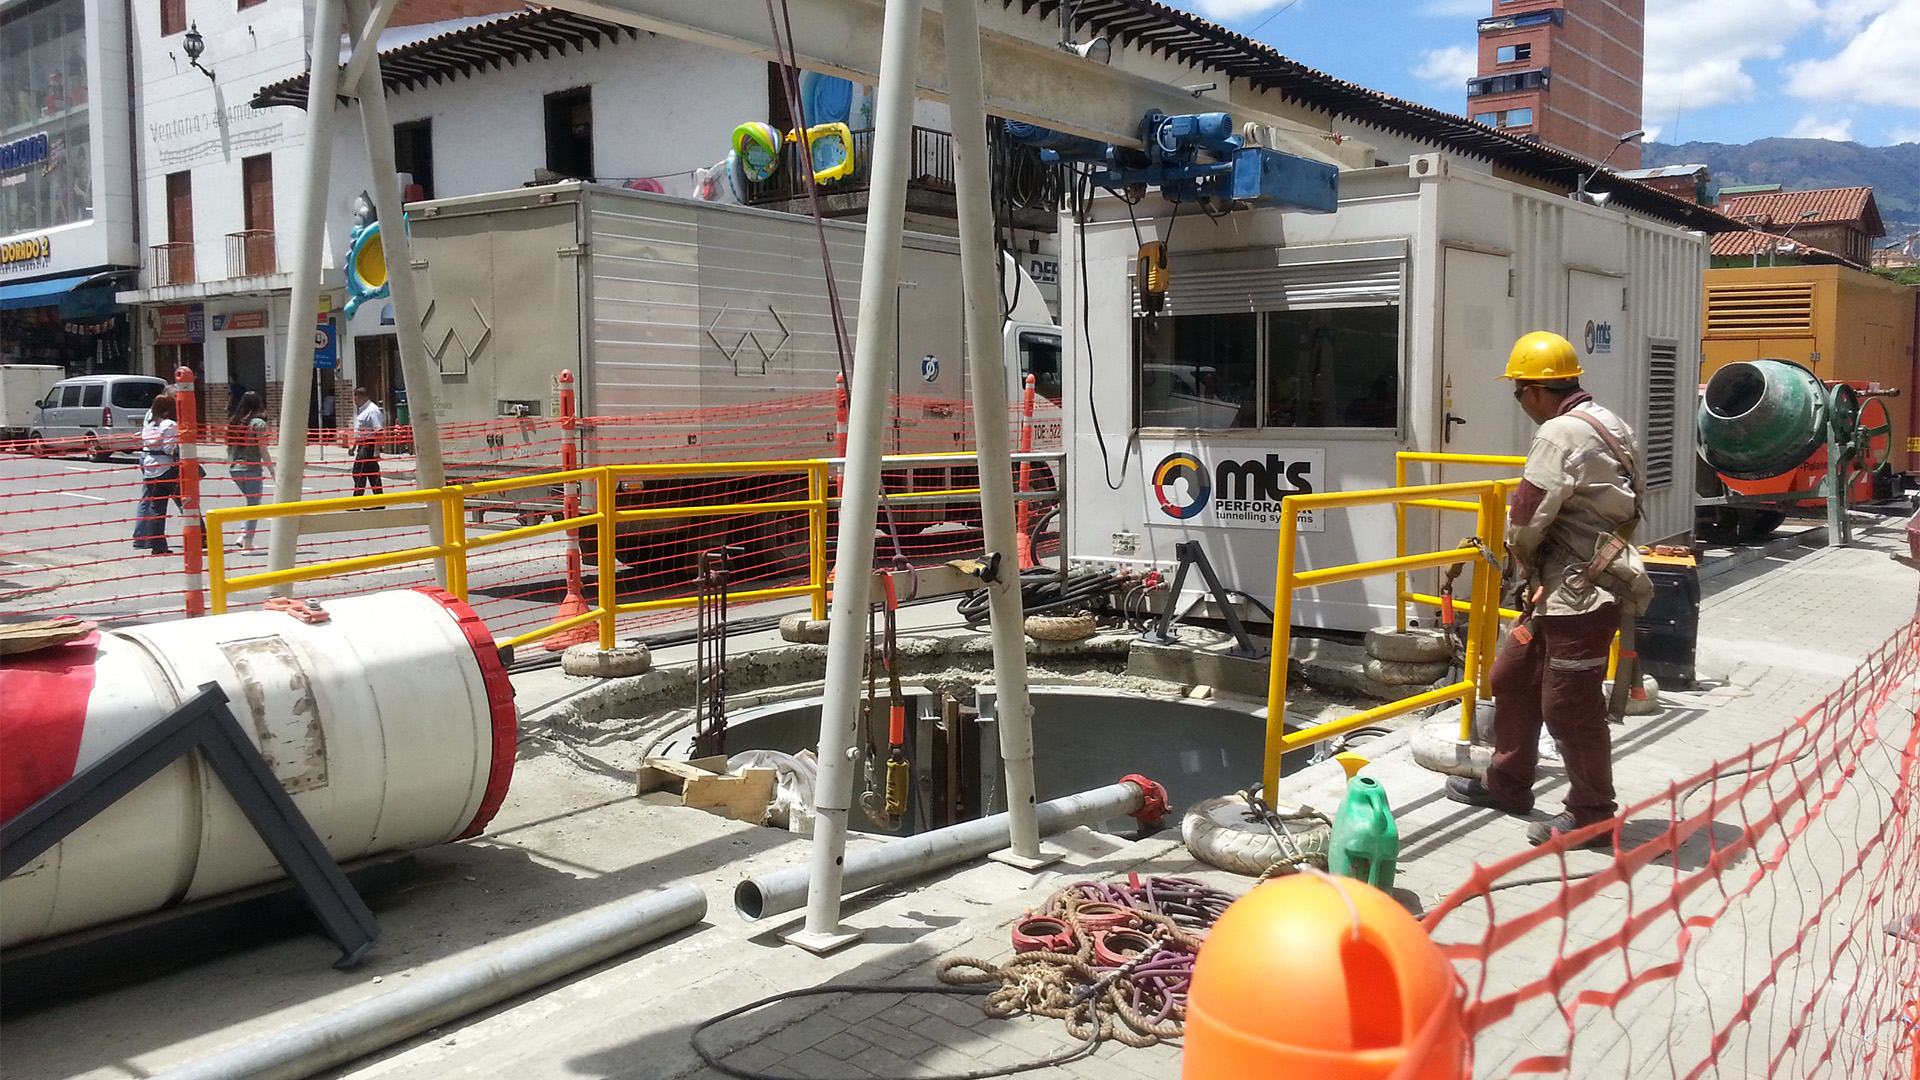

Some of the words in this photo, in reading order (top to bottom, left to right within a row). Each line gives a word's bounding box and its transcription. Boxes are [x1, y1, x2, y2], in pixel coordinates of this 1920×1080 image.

[2, 238, 41, 263] DORADO
[42, 236, 50, 256] 2
[1216, 453, 1313, 501] mts
[1215, 500, 1313, 515] PERFORA
[1216, 511, 1266, 523] tunnelling
[1269, 514, 1313, 524] syms
